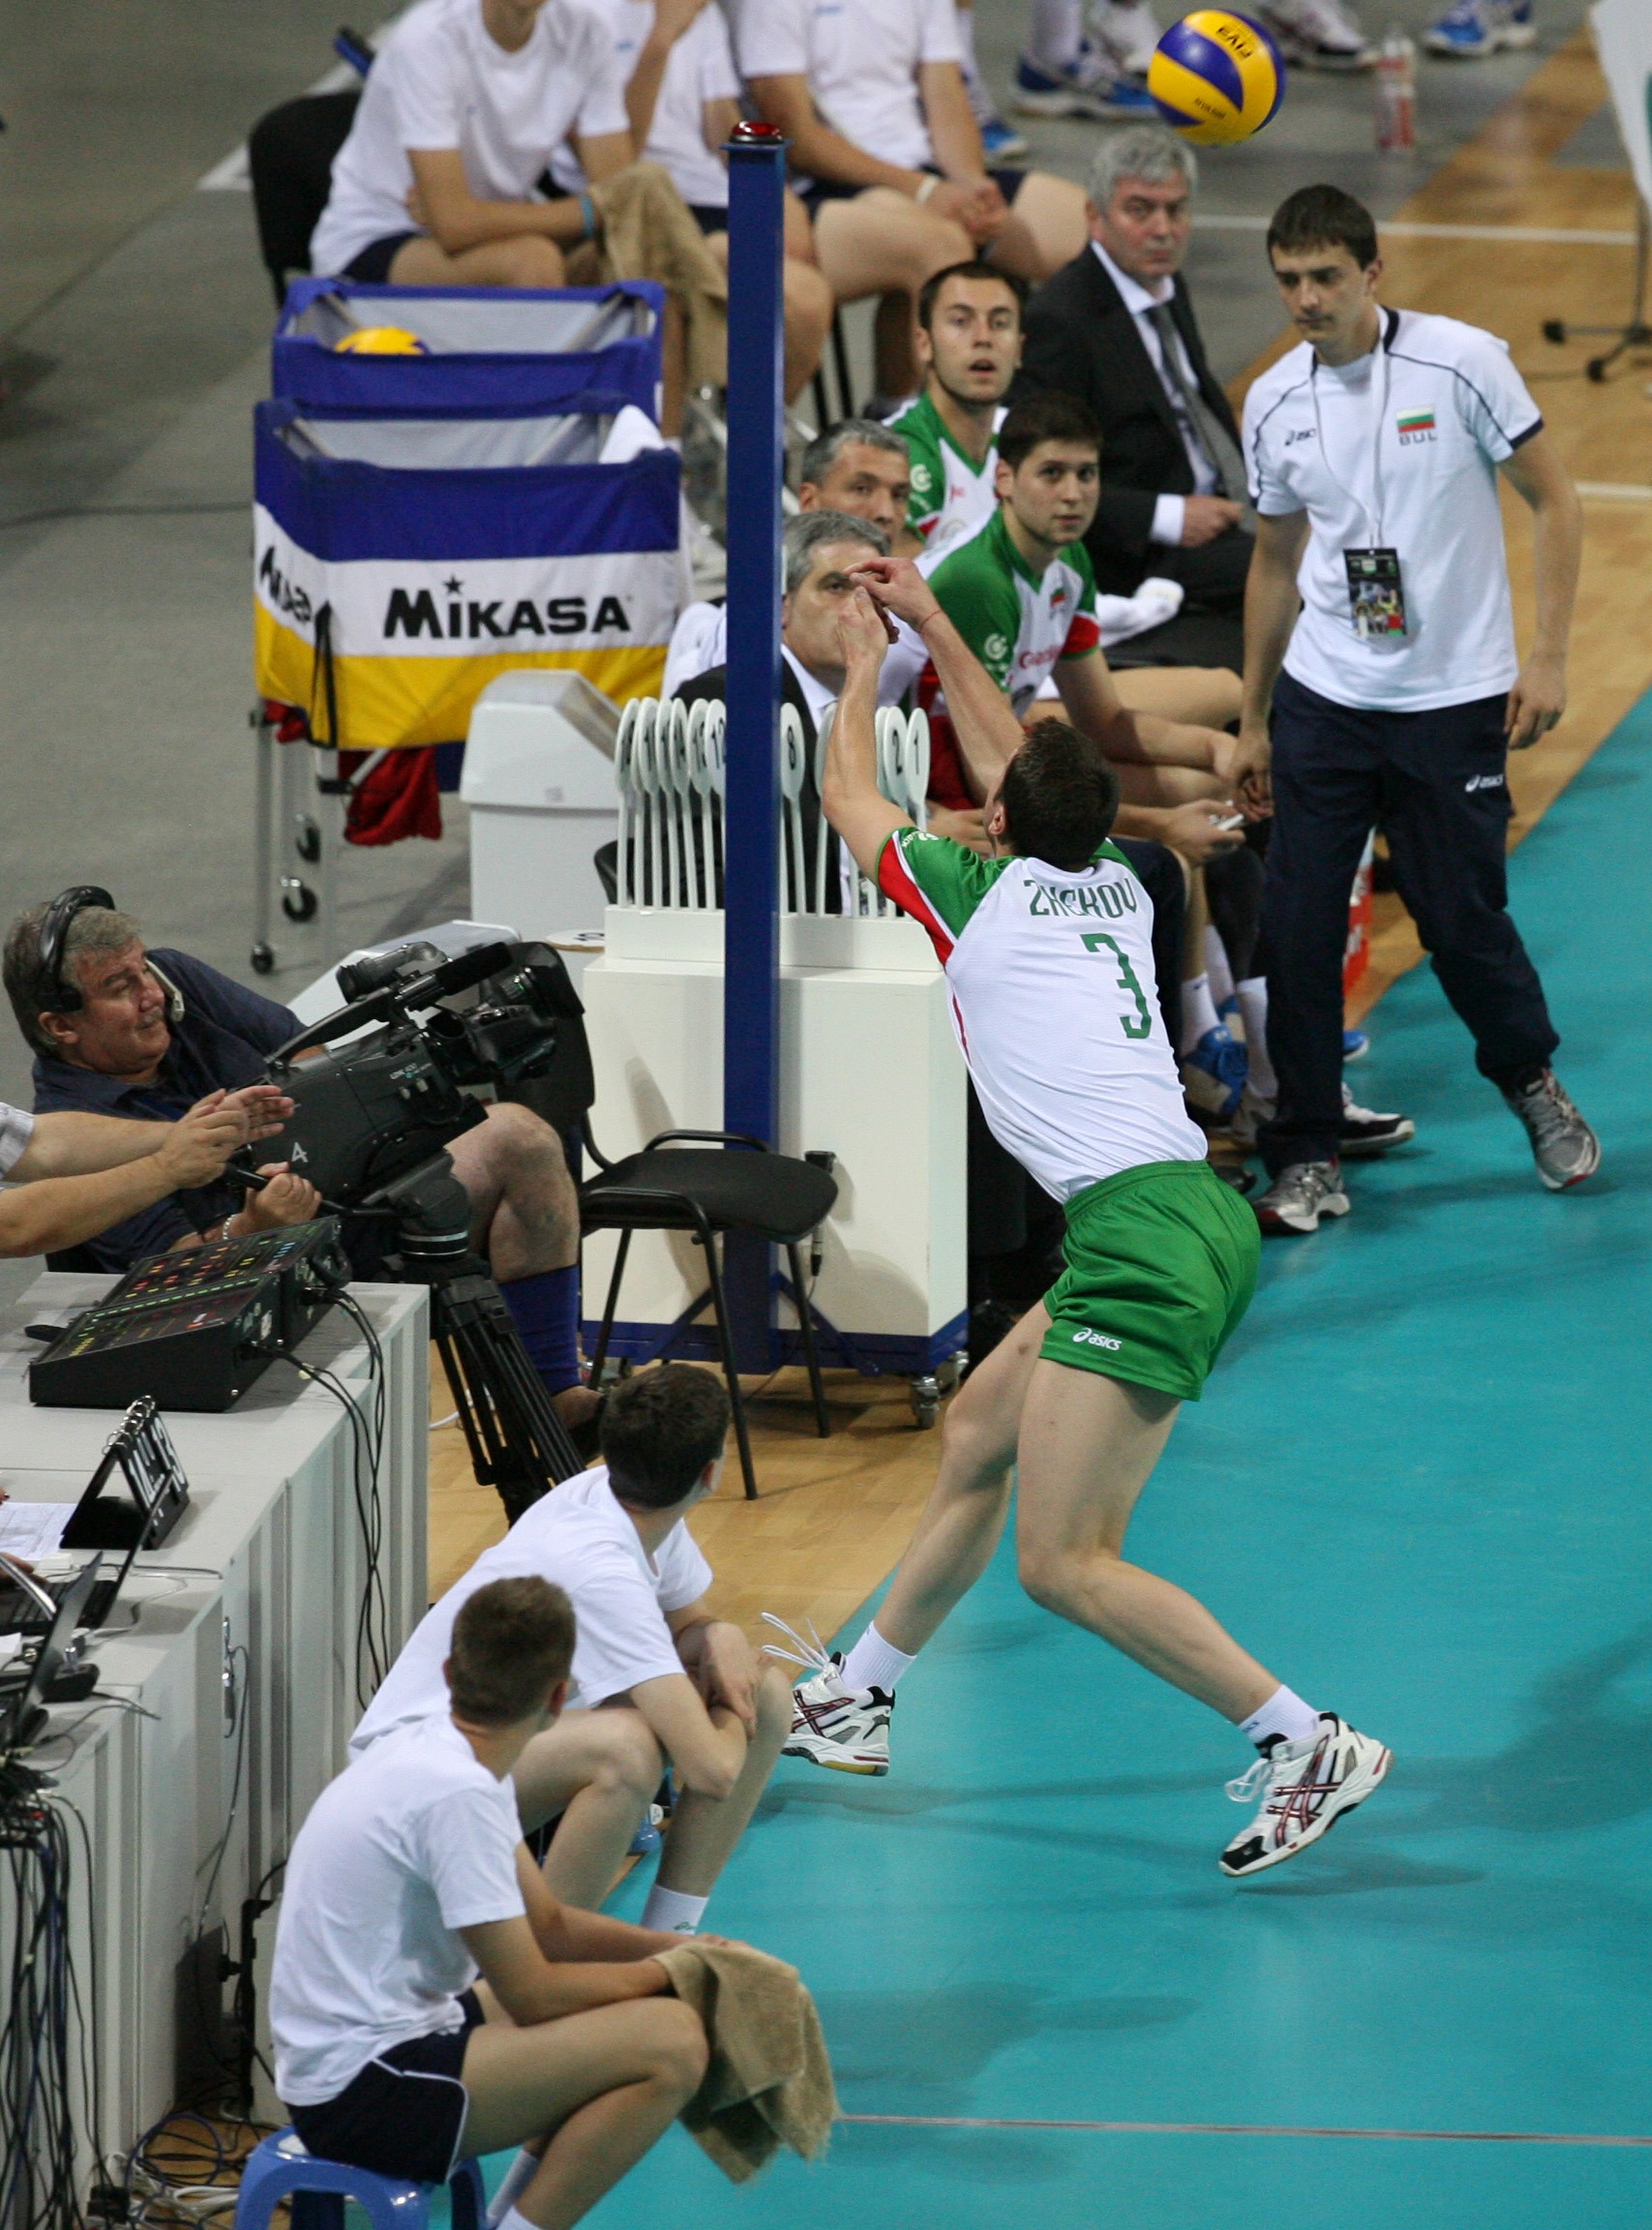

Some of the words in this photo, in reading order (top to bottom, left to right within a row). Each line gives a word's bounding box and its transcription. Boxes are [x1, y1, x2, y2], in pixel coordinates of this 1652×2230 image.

[1398, 431, 1438, 446] BUL
[787, 724, 797, 771] 8
[891, 728, 904, 775] 2
[1023, 878, 1138, 920] ZHEKOV
[1080, 932, 1153, 1040] 3
[291, 1142, 309, 1163] 4
[1088, 1333, 1123, 1351] asics
